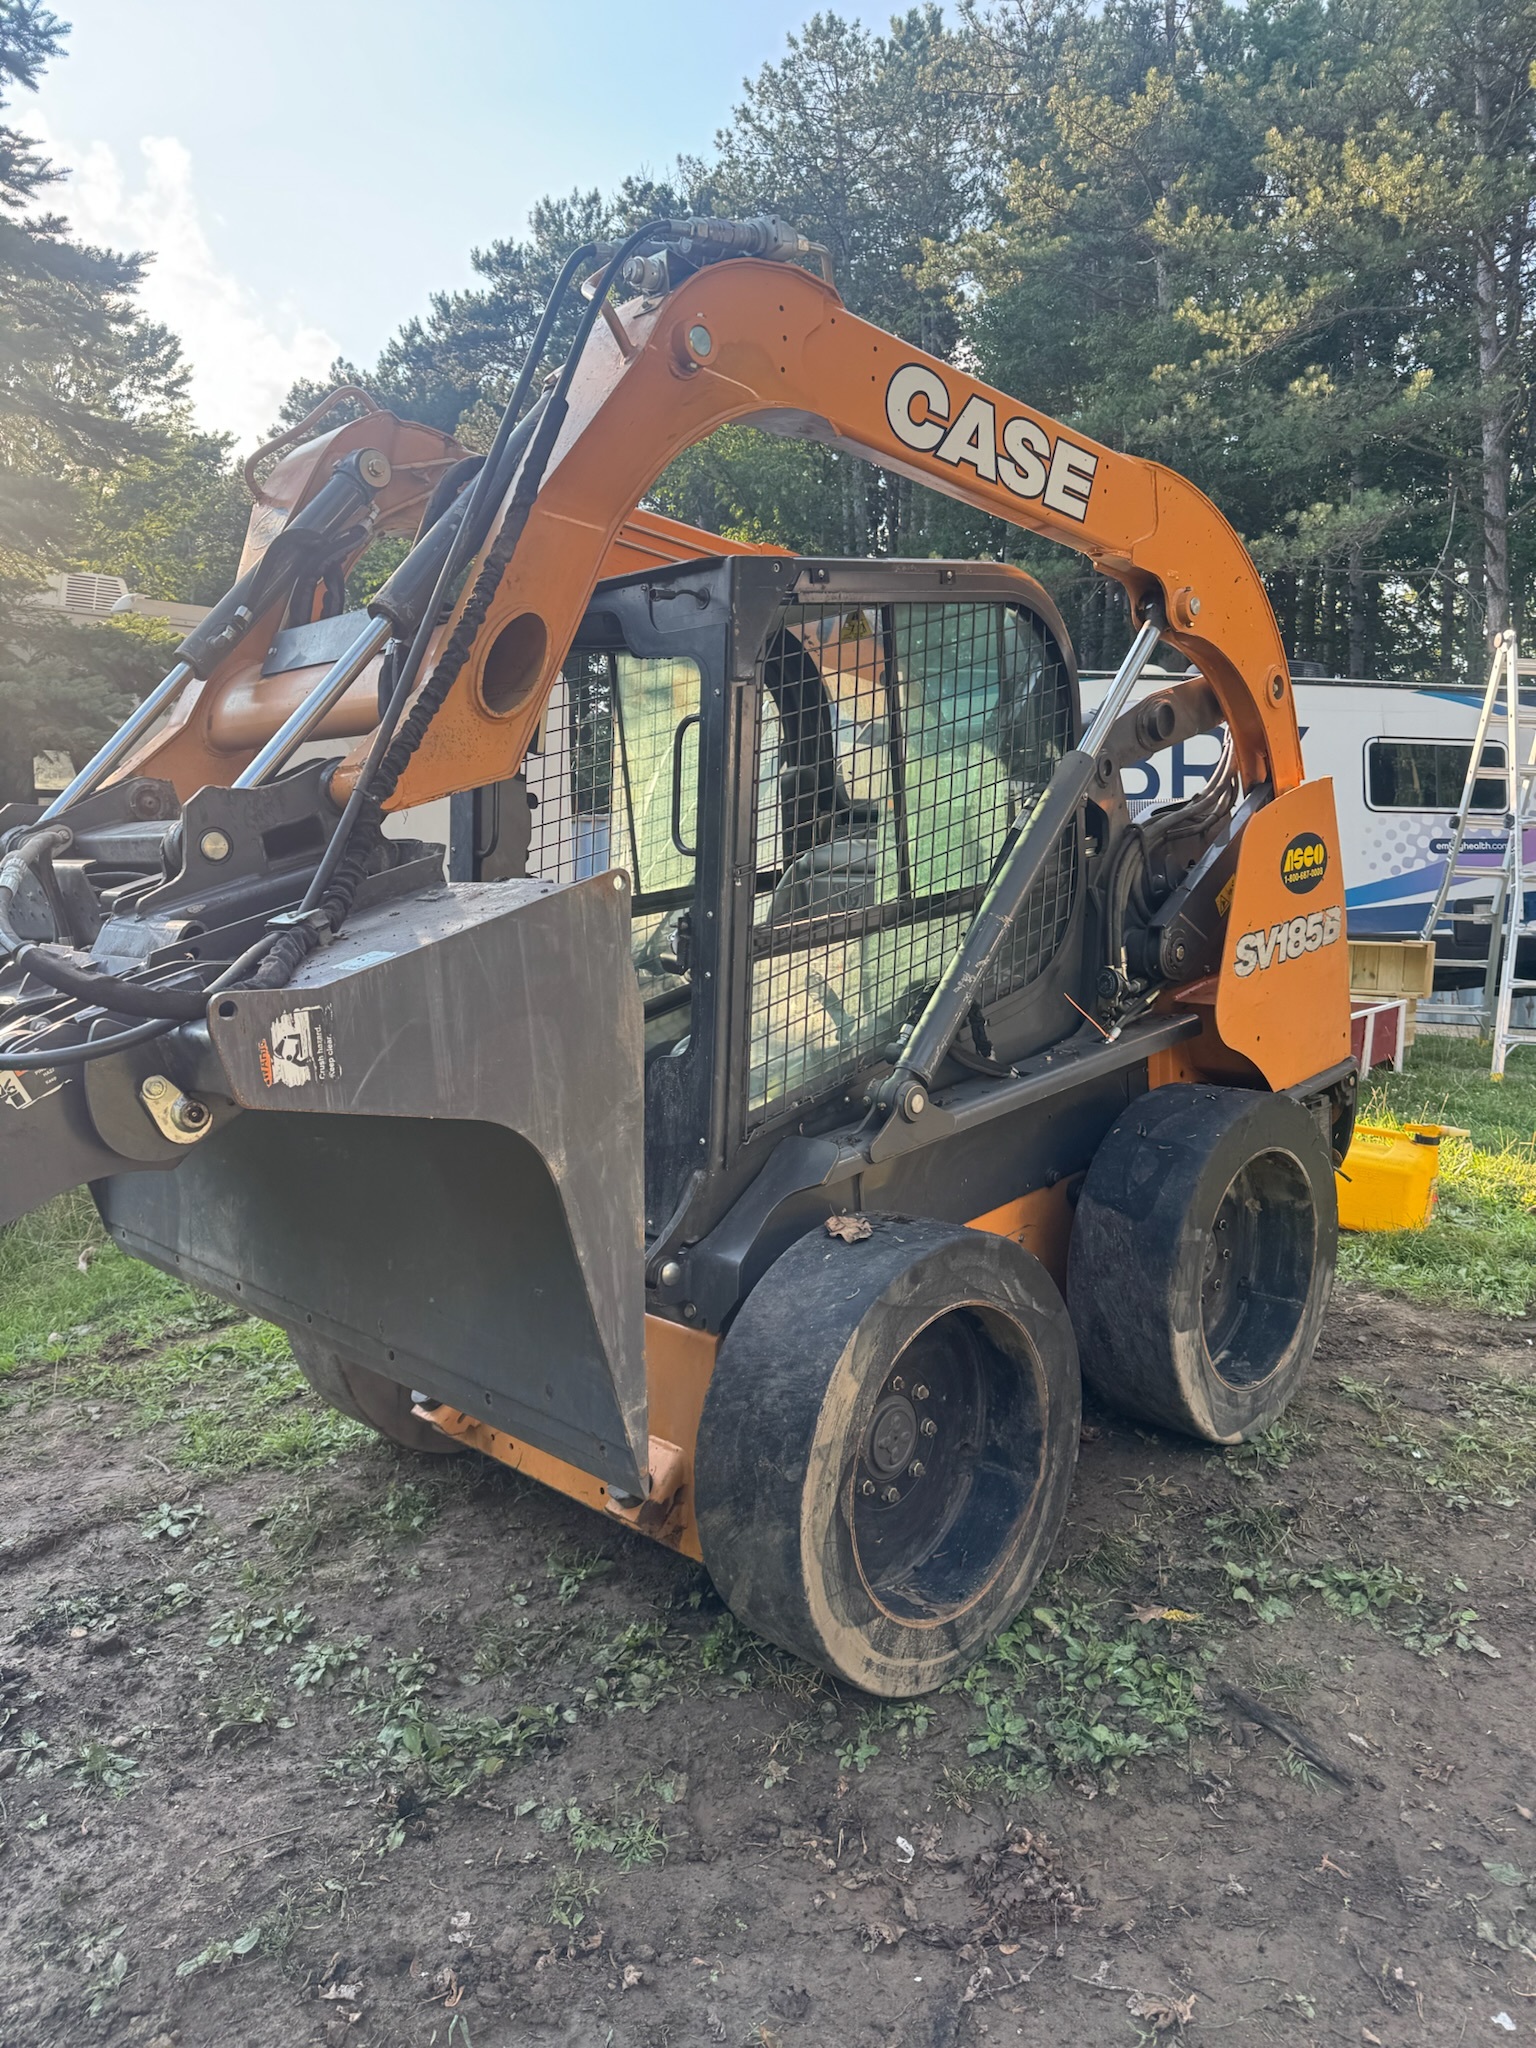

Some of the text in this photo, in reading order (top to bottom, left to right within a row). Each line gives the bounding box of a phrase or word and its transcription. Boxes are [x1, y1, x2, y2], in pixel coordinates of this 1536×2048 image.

[885, 362, 1099, 524] CASE
[1283, 843, 1324, 873] ASCO
[1234, 906, 1342, 978] SV185B
[314, 1024, 326, 1080] Crush hazard.
[326, 1033, 336, 1079] Keep clear.
